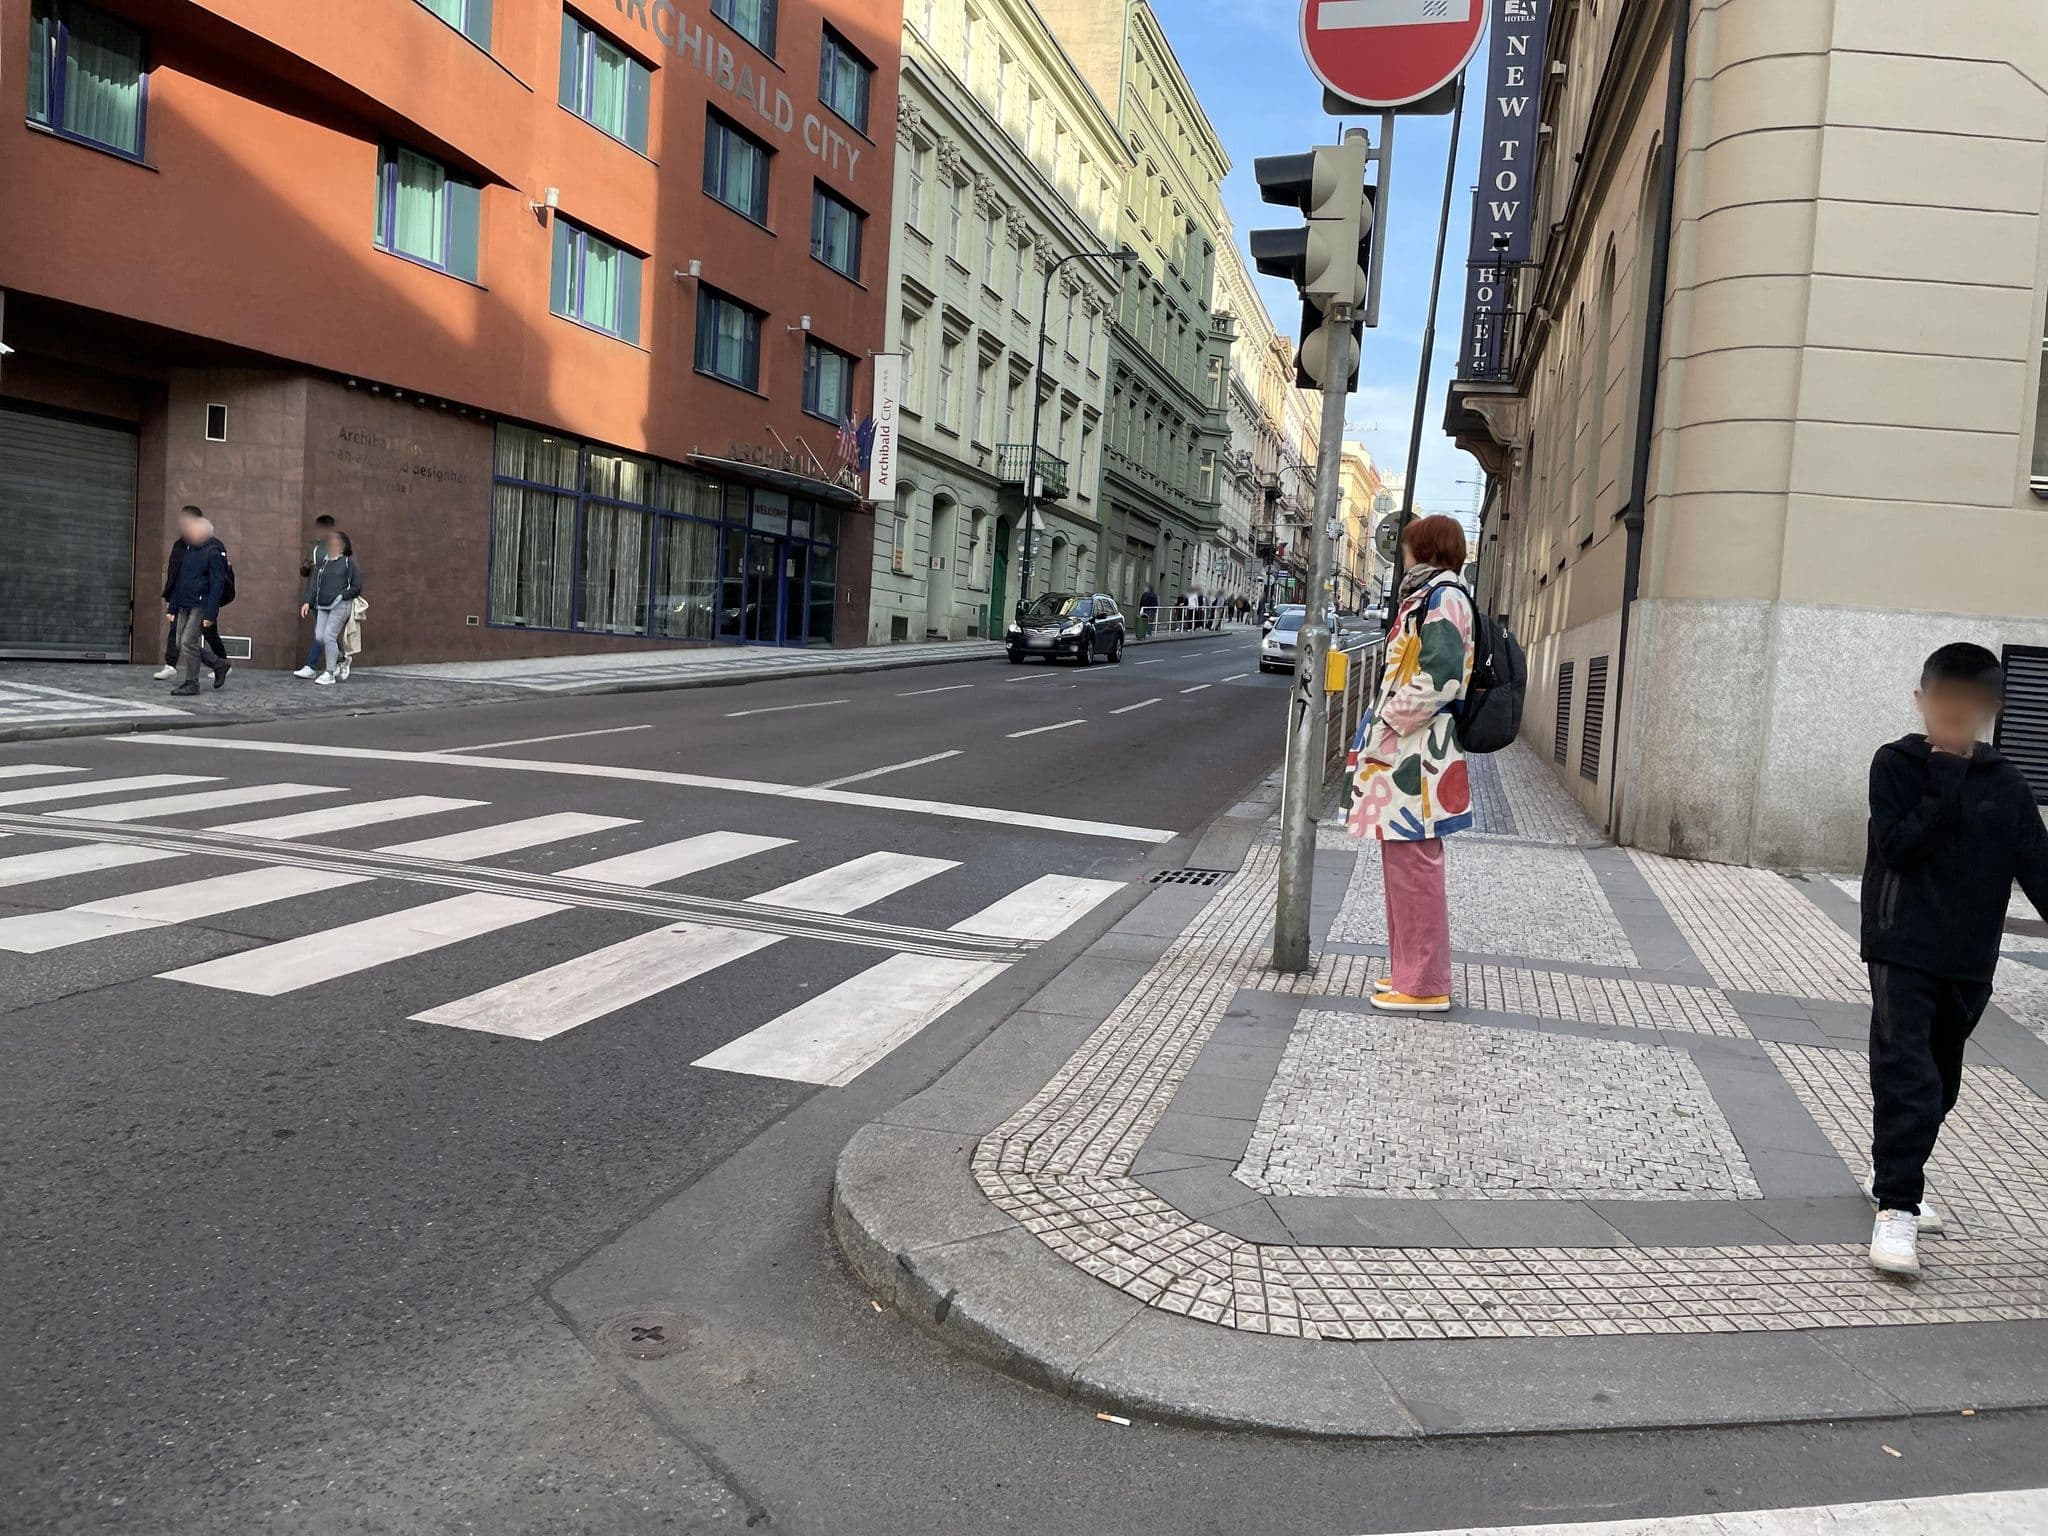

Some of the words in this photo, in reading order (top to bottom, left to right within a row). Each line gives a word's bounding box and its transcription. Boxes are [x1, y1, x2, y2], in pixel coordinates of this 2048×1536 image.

[614, 0, 794, 133] RCHIBALD
[803, 113, 862, 182] CITY
[1496, 35, 1531, 118] NEW
[1487, 140, 1521, 252] TOWN
[1472, 268, 1496, 374] HOTELS
[881, 397, 894, 421] City
[878, 426, 890, 486] Archibald
[755, 504, 787, 519] WELCOME
